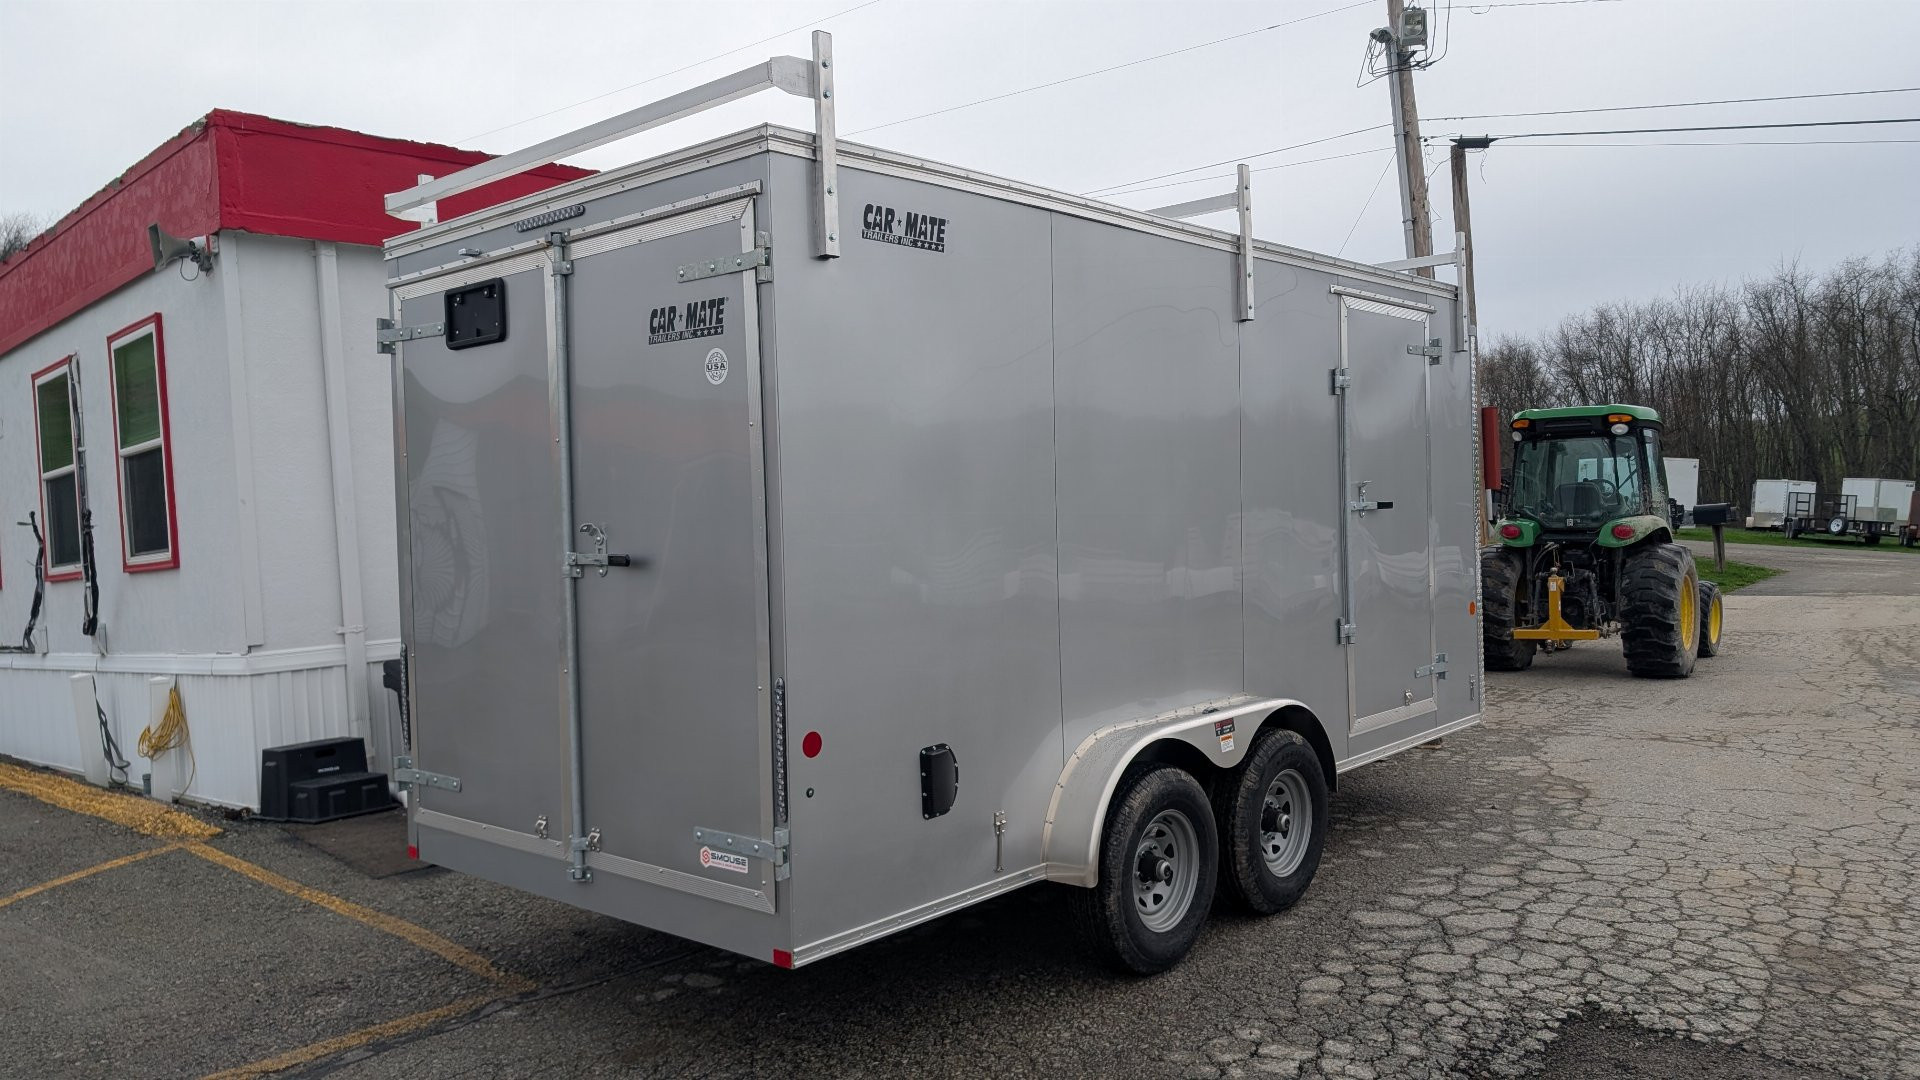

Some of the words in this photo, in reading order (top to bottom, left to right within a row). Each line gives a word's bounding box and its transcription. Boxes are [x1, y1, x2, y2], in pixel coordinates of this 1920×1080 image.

[863, 204, 895, 233] CAR
[905, 212, 946, 243] MATE
[863, 231, 899, 244] TRAILERS
[900, 237, 915, 246] INC.
[649, 306, 677, 335] CAR
[685, 297, 725, 330] MATE
[650, 333, 681, 344] TRAILERS
[707, 362, 726, 371] USA
[710, 852, 747, 866] SMOUSE
